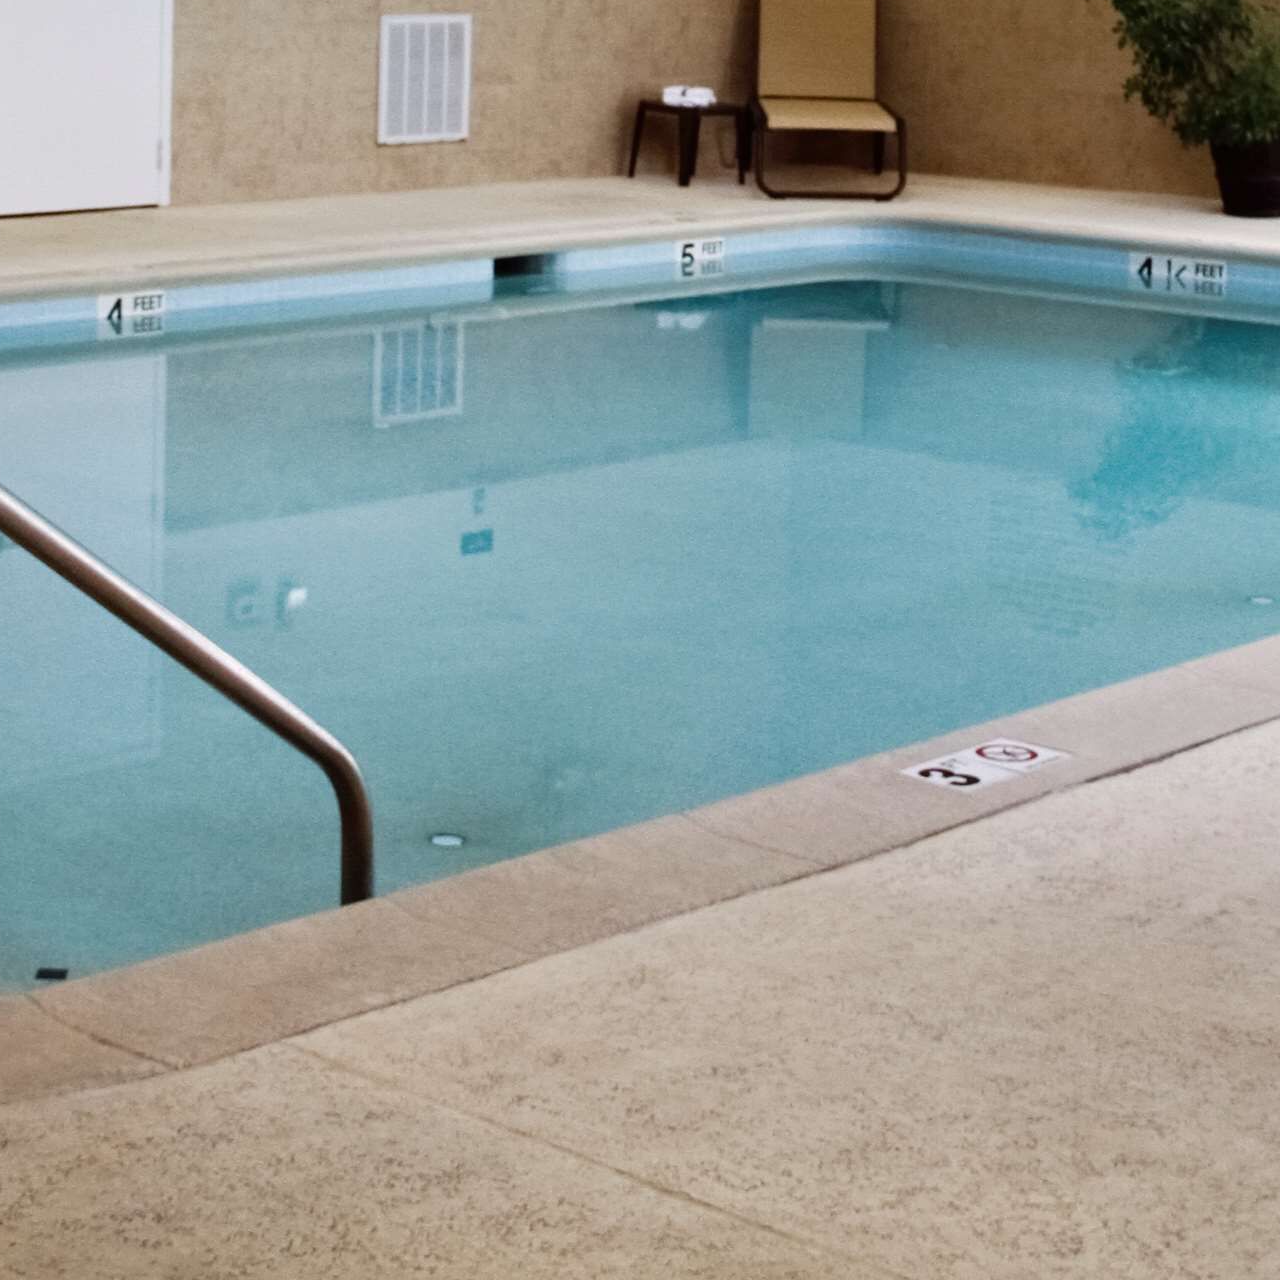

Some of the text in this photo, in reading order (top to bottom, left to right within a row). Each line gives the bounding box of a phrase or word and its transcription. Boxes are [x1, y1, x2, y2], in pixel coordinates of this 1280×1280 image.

[682, 242, 694, 262] 5
[133, 294, 164, 312] FEET
[918, 767, 981, 787] 3
